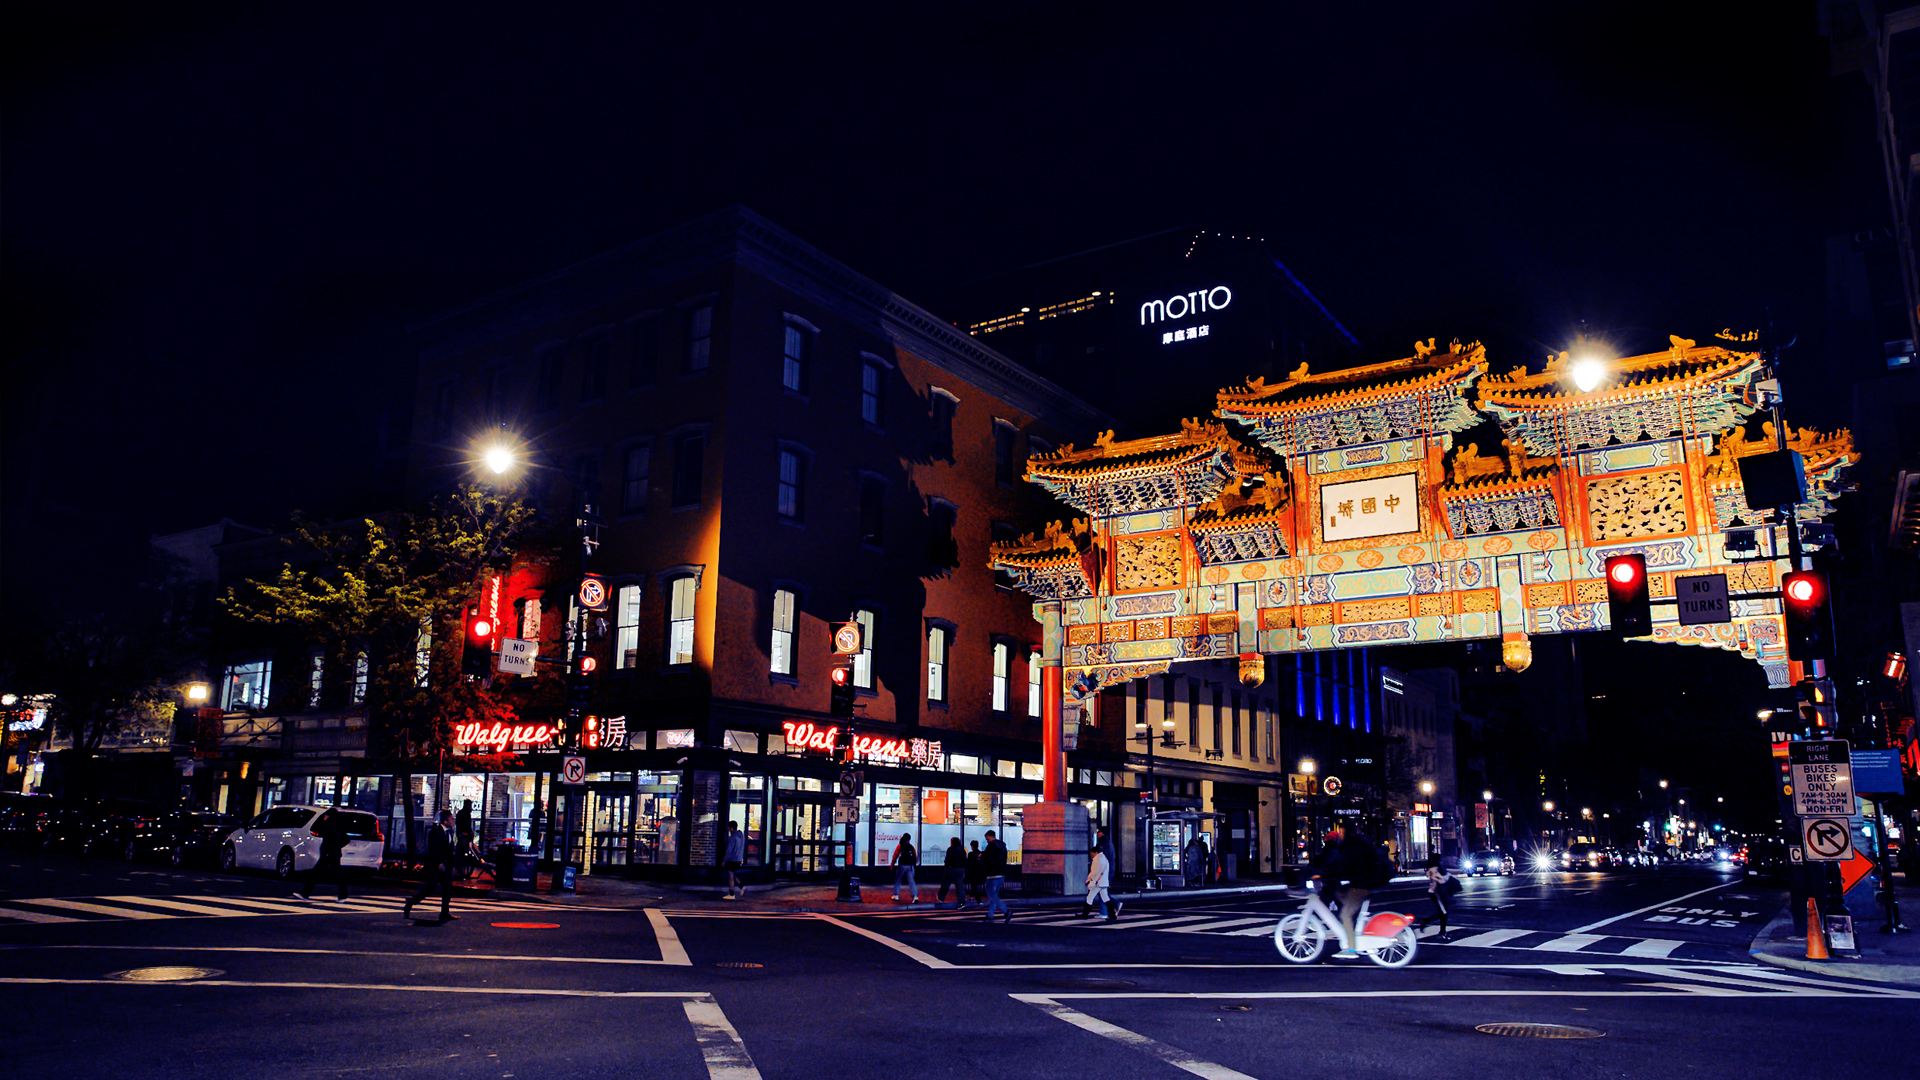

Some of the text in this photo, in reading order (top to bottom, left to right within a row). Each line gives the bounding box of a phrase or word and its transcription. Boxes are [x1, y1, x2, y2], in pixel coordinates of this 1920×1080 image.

[1693, 580, 1710, 593] NO
[1684, 599, 1724, 613] TURNS
[513, 643, 525, 652] NO
[504, 655, 530, 666] TURNS
[456, 716, 627, 751] Walgree 房
[783, 722, 910, 758] Walreens
[1804, 764, 1837, 773] BUSES
[1806, 774, 1837, 782] BIKES
[1808, 783, 1836, 791] ONLY
[1806, 805, 1844, 813] MON-FRI
[1658, 907, 1759, 917] ONLY
[1643, 915, 1740, 928] BUS
